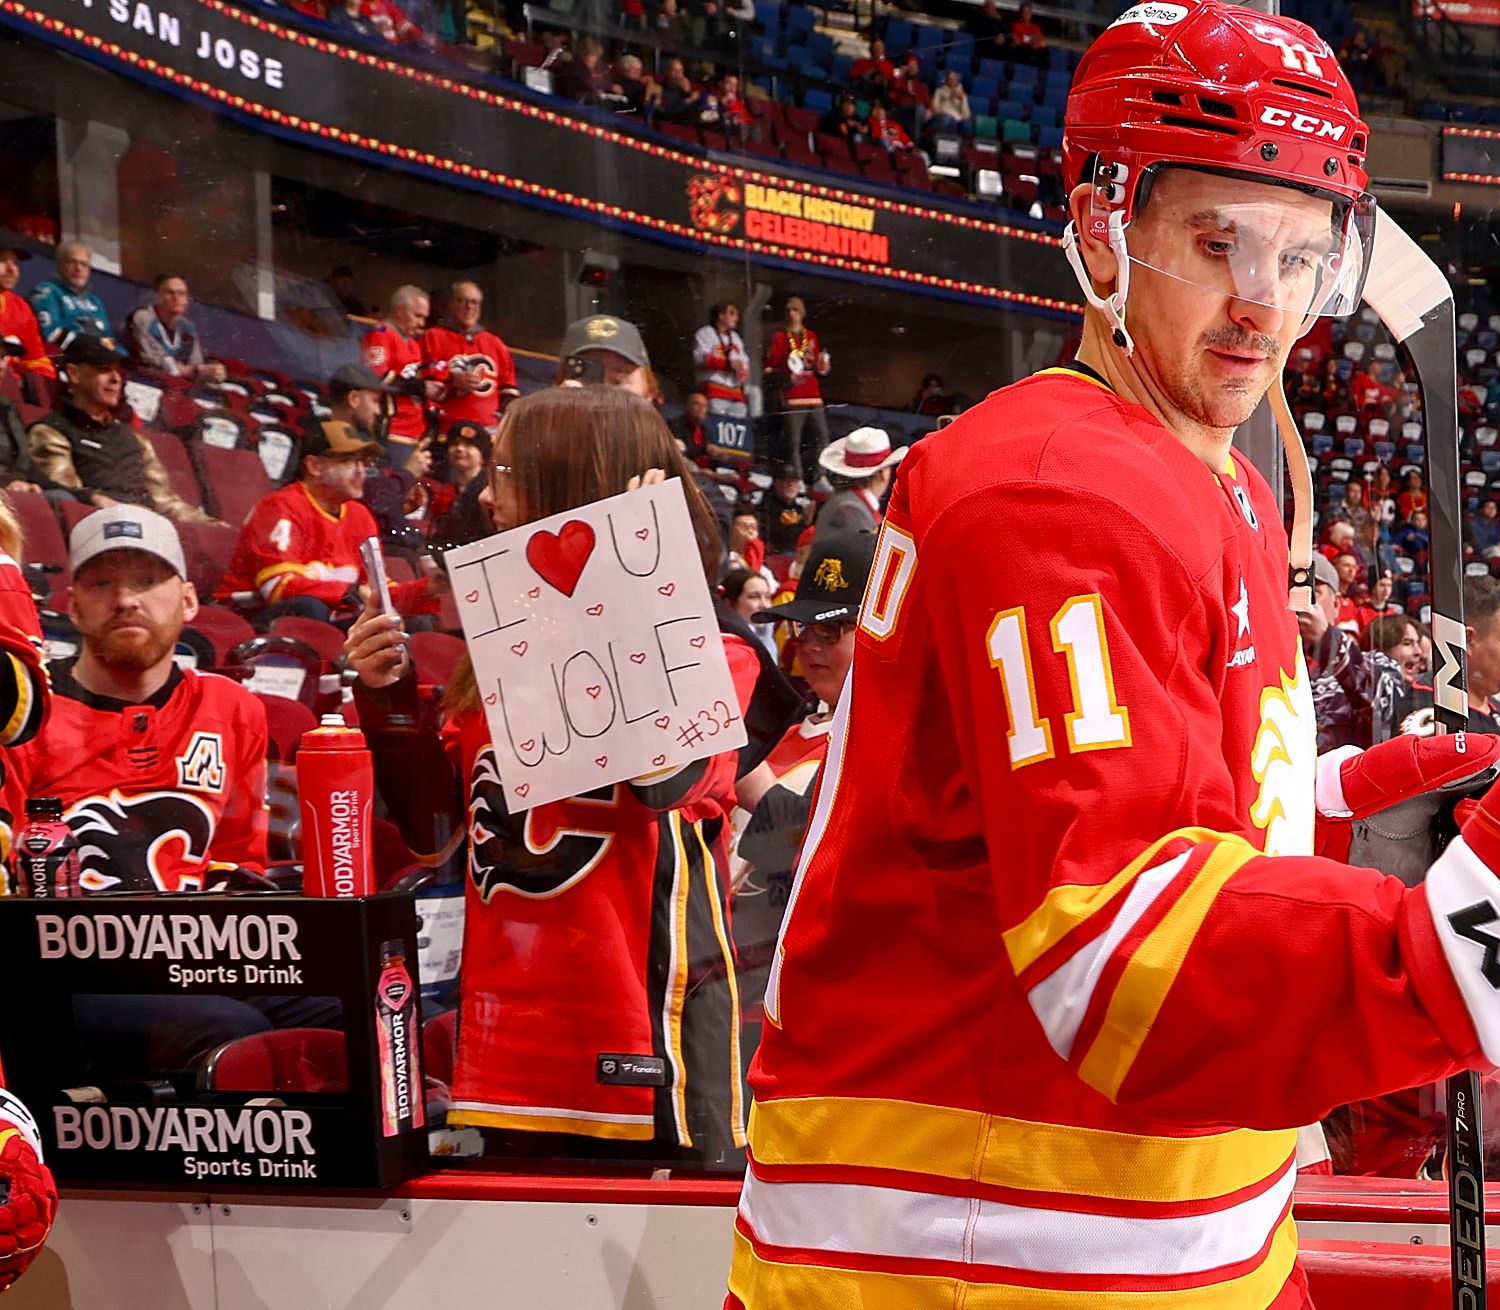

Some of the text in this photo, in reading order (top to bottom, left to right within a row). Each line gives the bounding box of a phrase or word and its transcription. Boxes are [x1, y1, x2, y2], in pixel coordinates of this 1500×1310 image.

[109, 0, 284, 89] SAN JOSE
[1260, 105, 1346, 141] CCM
[744, 183, 875, 232] BLACK HISTORY
[744, 209, 890, 264] CELEBRATION
[717, 421, 747, 446] 107
[268, 518, 292, 551] 4
[454, 499, 661, 639] I U
[815, 607, 848, 621] CCM
[497, 616, 703, 768] WOLF
[985, 592, 1133, 772] 11
[676, 700, 740, 748] #32
[174, 730, 226, 794] A
[351, 817, 360, 849] Sports
[36, 914, 302, 961] BODYARMOR
[168, 964, 304, 988] Sports Drink
[392, 1012, 411, 1121] BODYARMOR
[52, 1105, 316, 1155] BODYARMOR
[184, 1157, 318, 1180] Sports Drink
